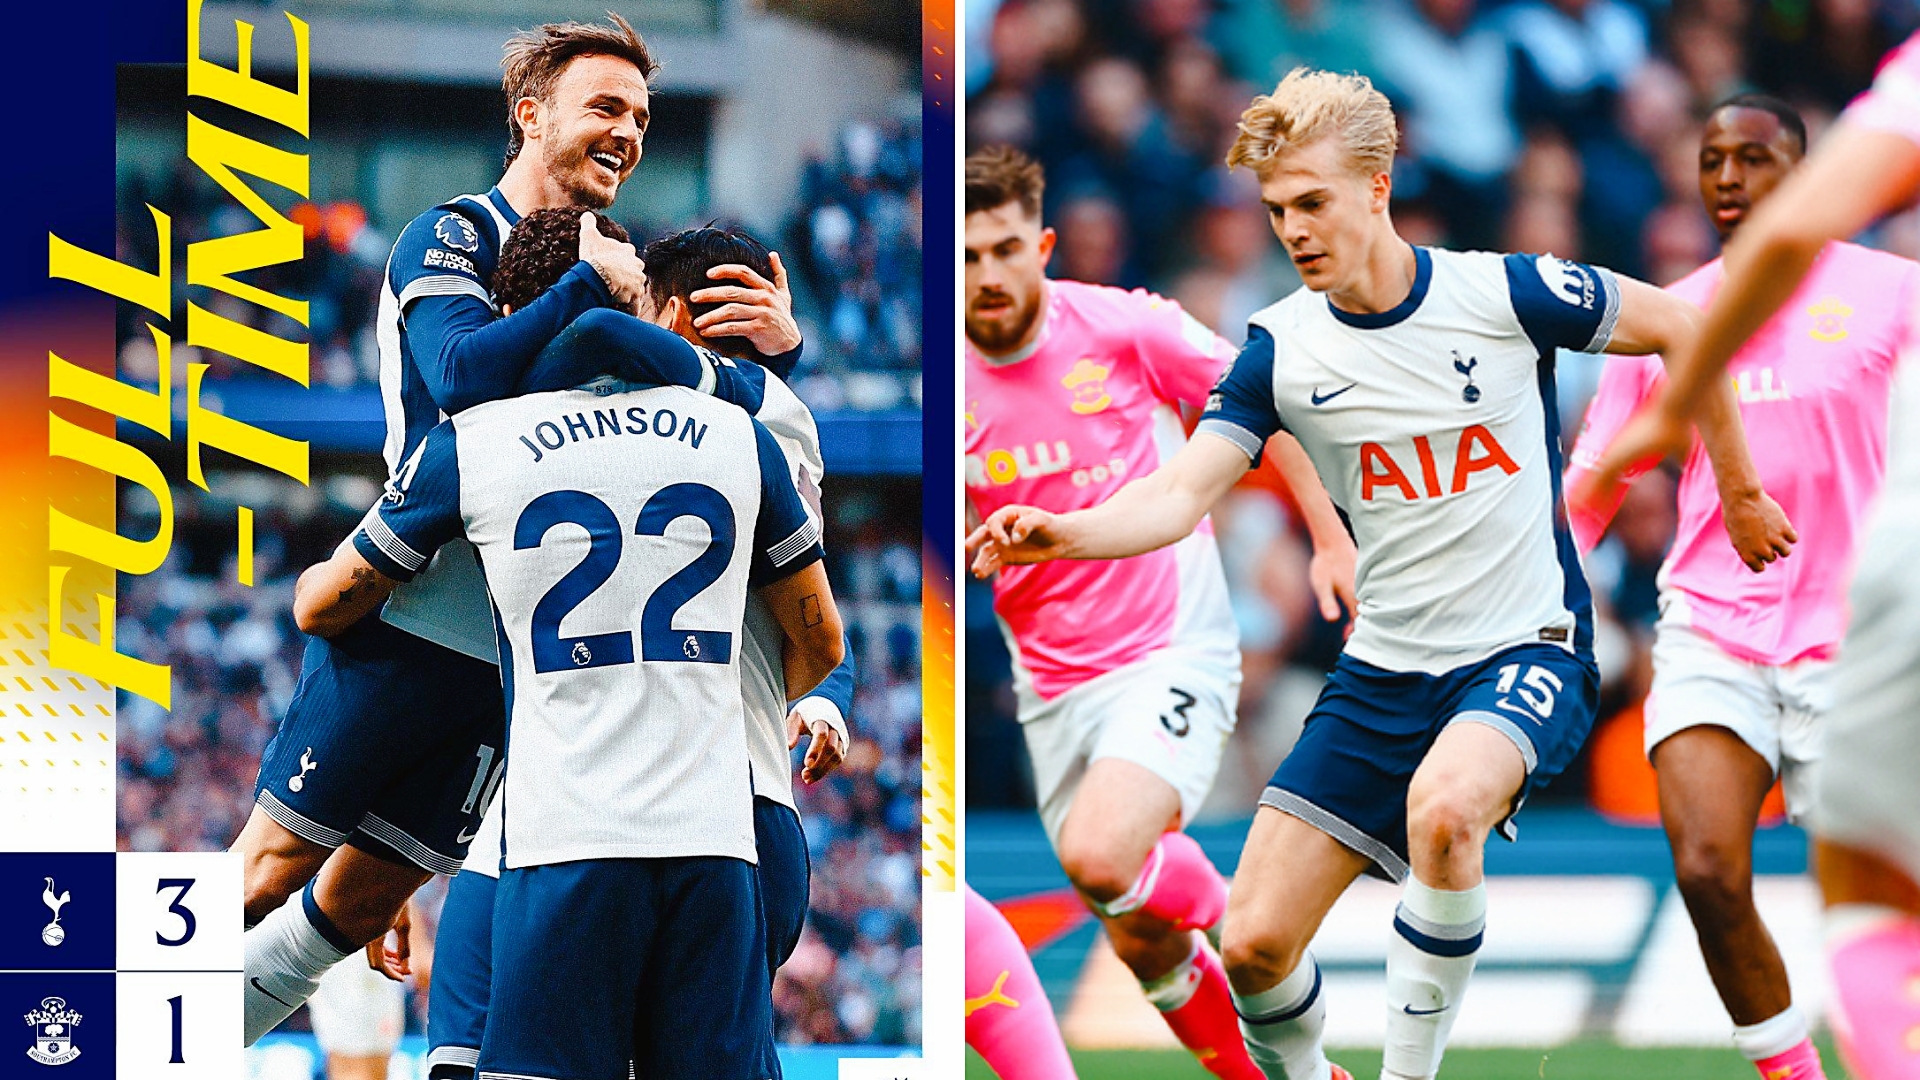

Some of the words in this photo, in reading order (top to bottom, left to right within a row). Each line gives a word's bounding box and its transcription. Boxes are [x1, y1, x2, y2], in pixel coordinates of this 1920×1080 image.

[519, 407, 707, 462] JOHNSON
[1360, 424, 1521, 502] AIA
[514, 483, 735, 674] 22
[1160, 686, 1197, 738] 3
[1495, 663, 1563, 718] 15
